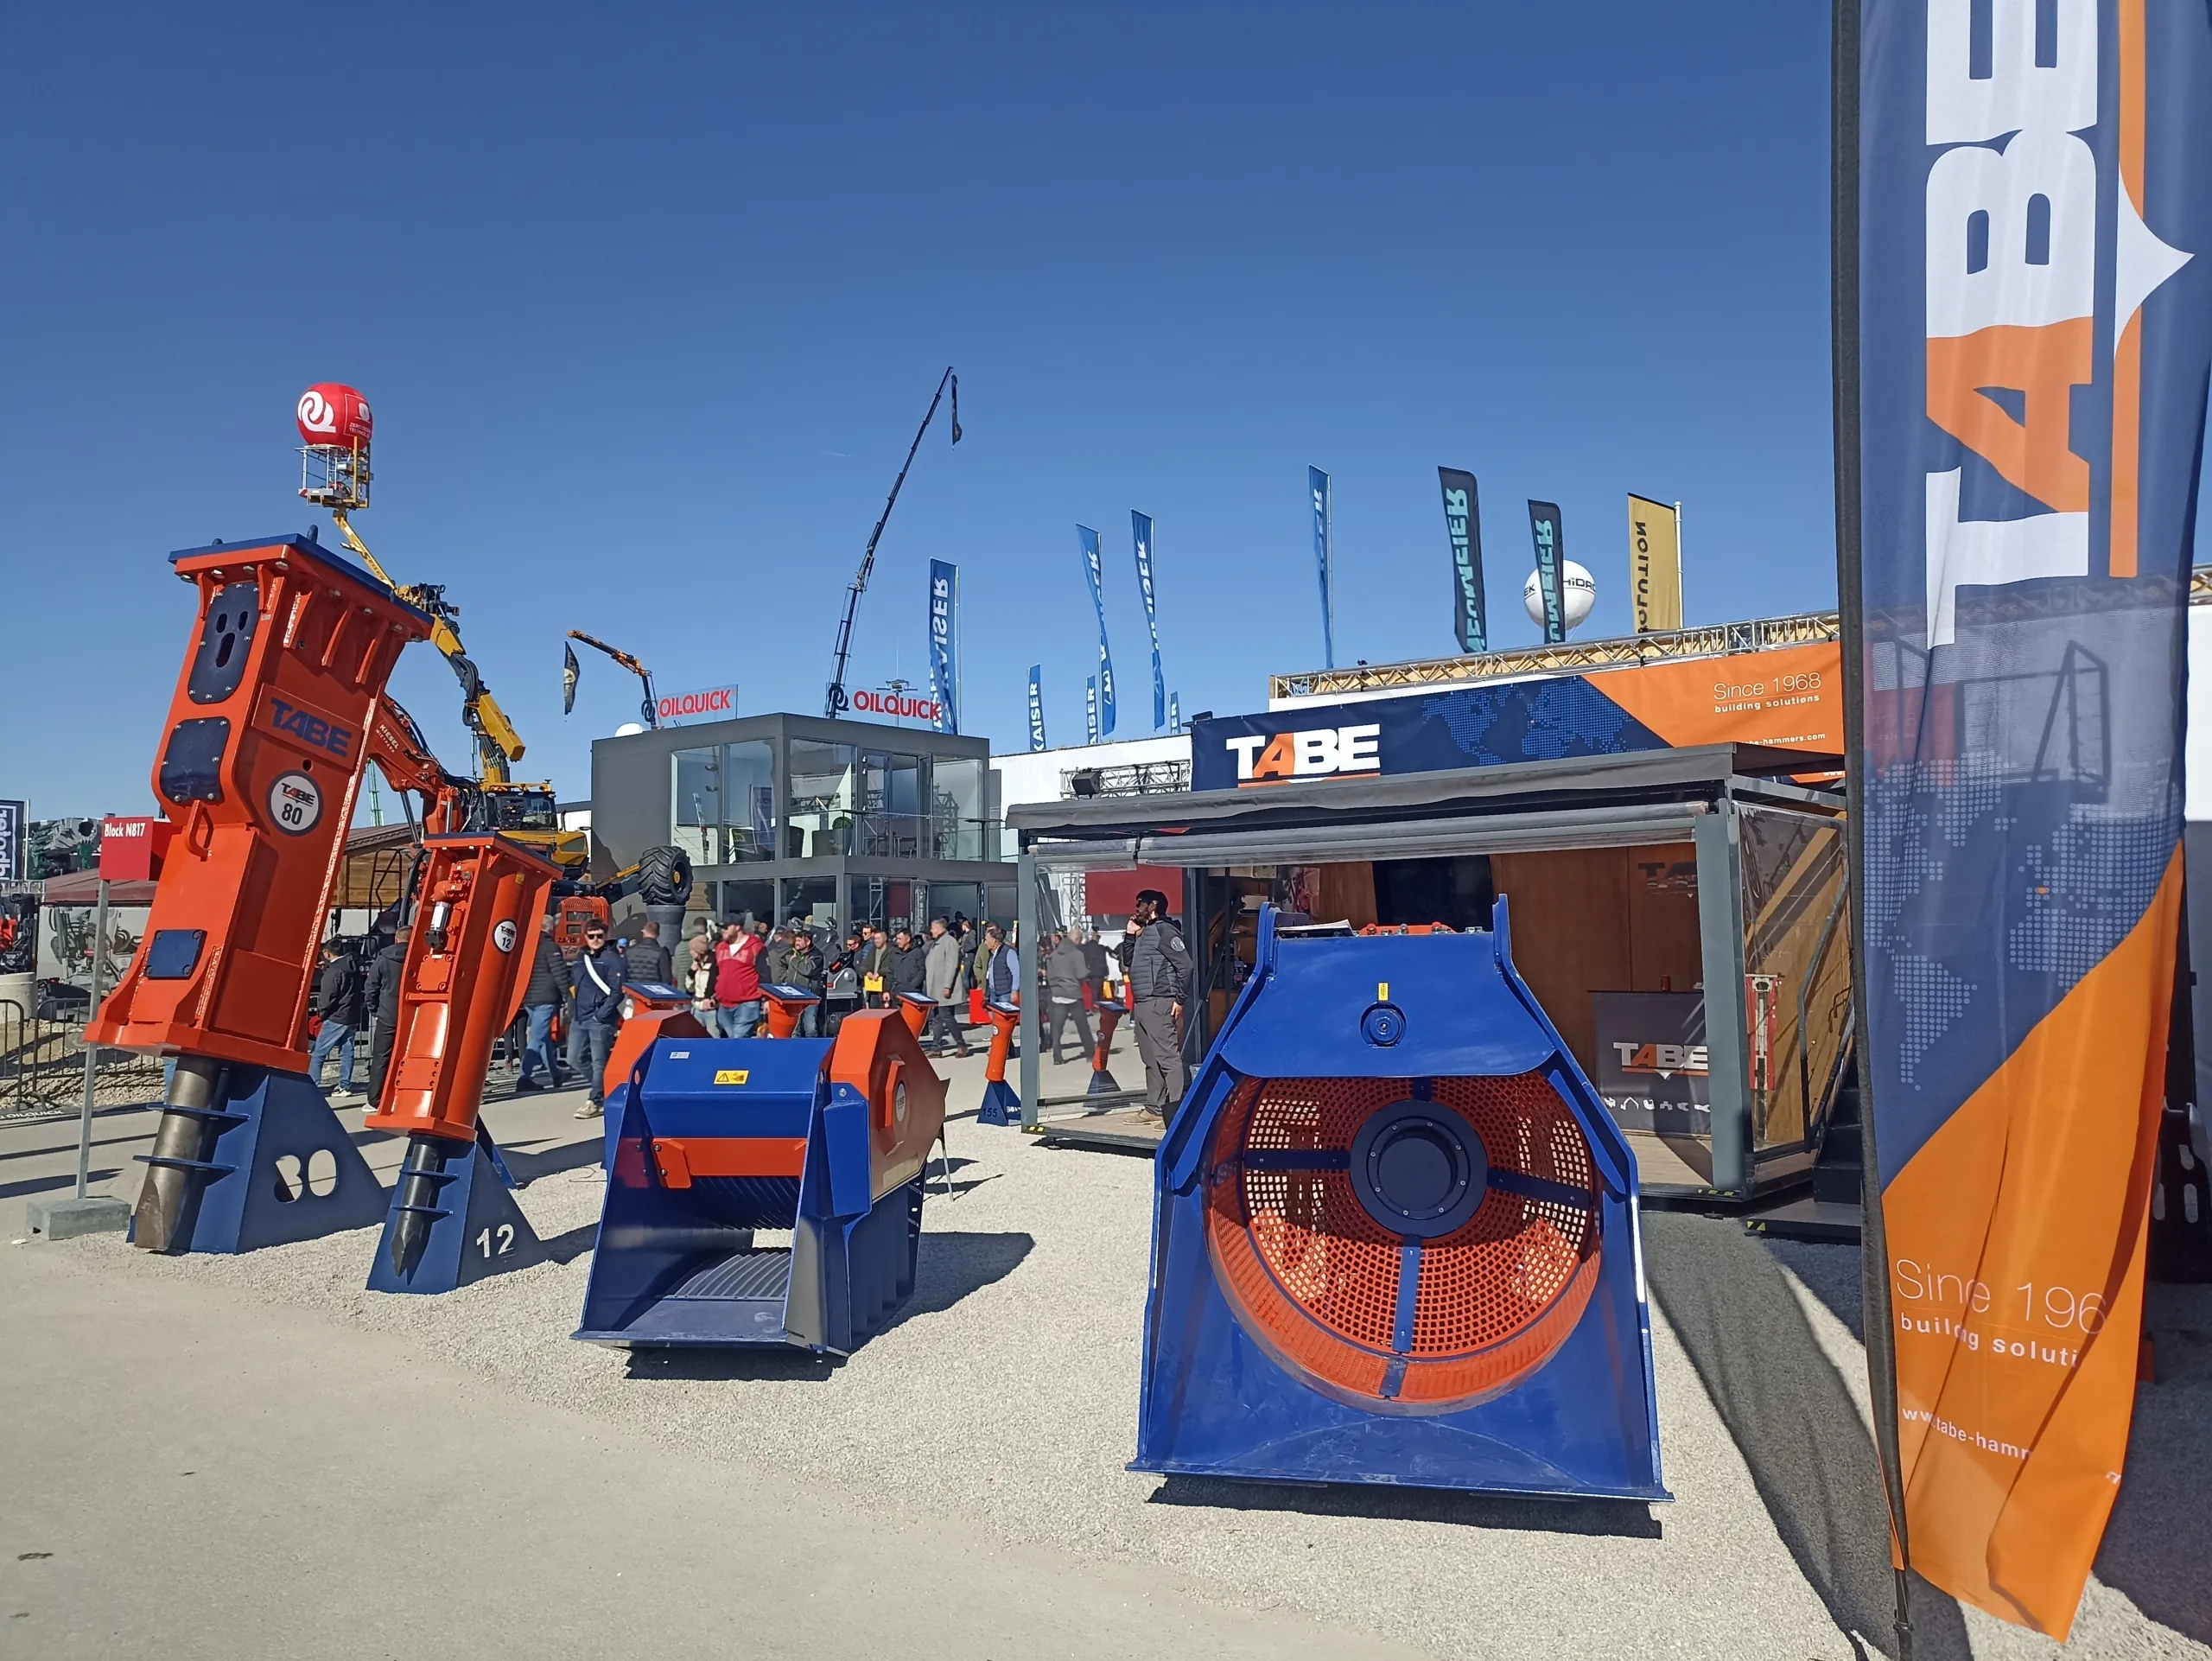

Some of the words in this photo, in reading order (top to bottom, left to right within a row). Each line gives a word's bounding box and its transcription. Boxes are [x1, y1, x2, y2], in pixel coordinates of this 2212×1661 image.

[1927, 0, 2097, 650] TABE
[1713, 682, 1764, 700] Since
[1773, 671, 1821, 693] 1968
[658, 689, 732, 717] OILQUICK
[853, 690, 942, 721] OILQUICK
[1088, 687, 1097, 745] AISER
[1714, 701, 1761, 714] building
[1765, 693, 1821, 708] solutions
[270, 697, 353, 758] TABE
[380, 724, 398, 749] KIESEL
[1226, 723, 1381, 780] TABE
[281, 781, 315, 805] TABE
[281, 802, 303, 826] 80
[104, 823, 124, 837] Block
[125, 821, 146, 838] N817
[500, 925, 516, 938] TABE
[502, 937, 512, 950] 12
[1612, 1041, 1708, 1070] TABE
[6, 1110, 64, 1119] OILQUICK
[982, 1108, 998, 1119] 155
[476, 1224, 516, 1259] 12
